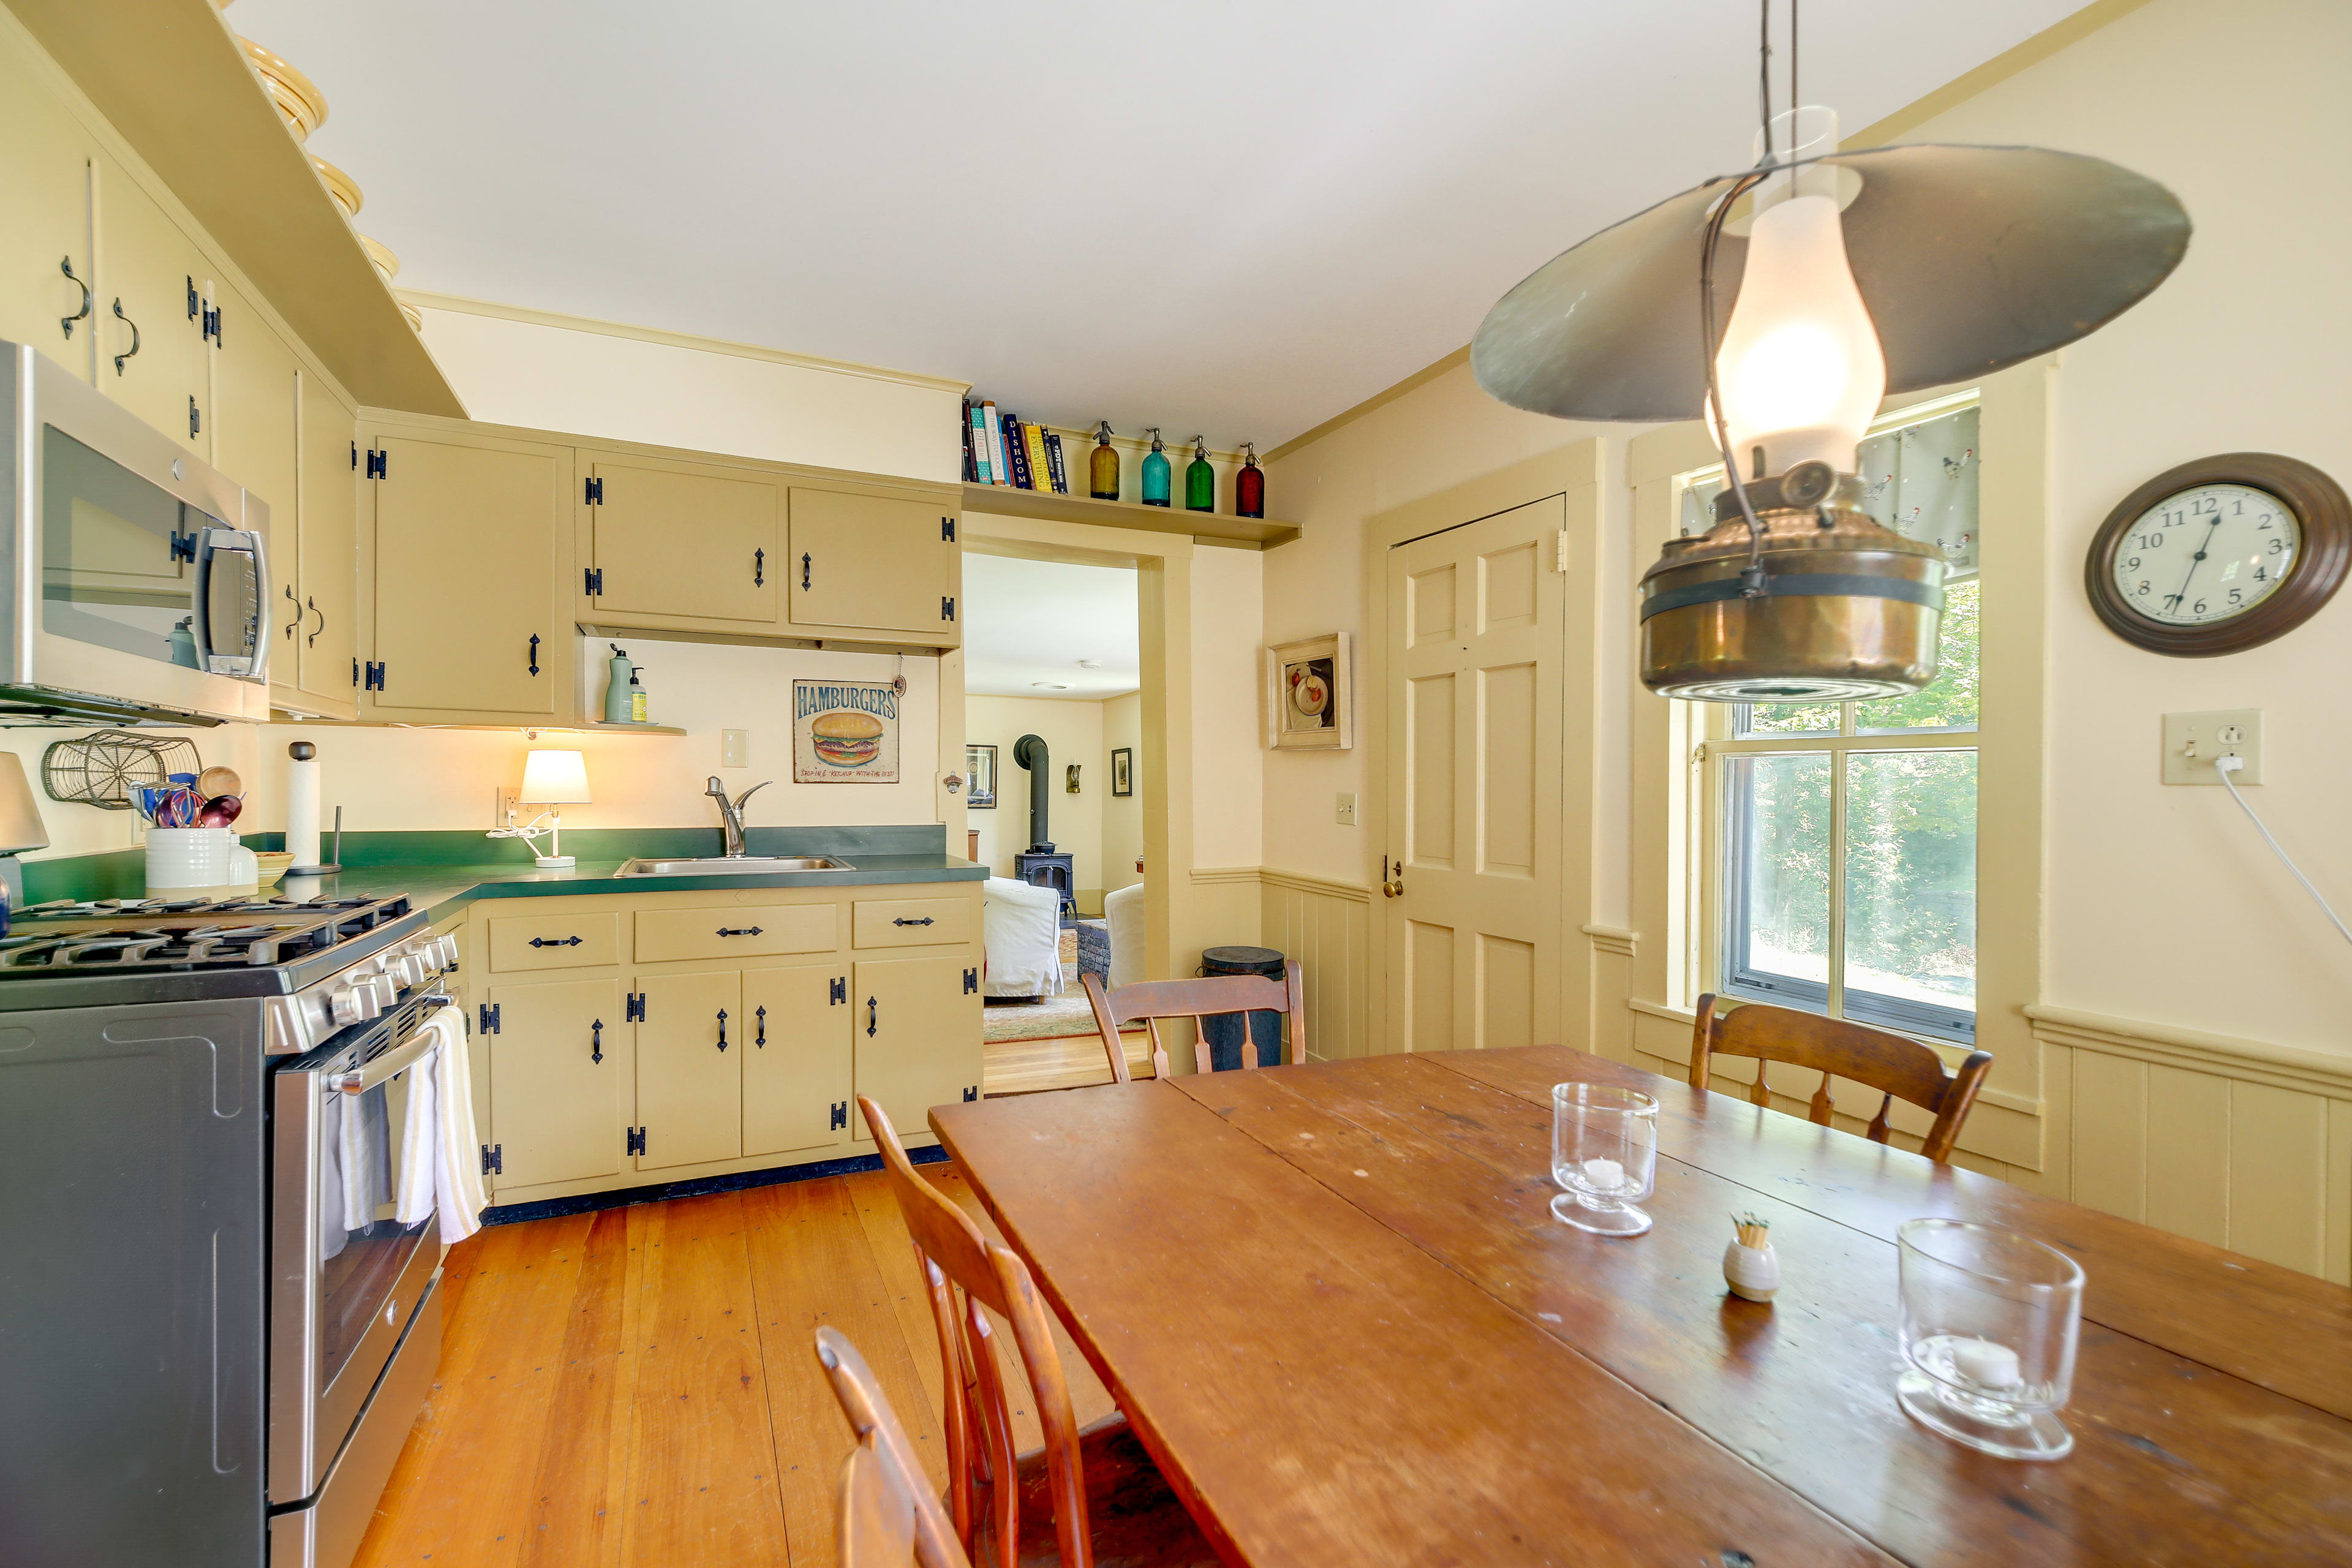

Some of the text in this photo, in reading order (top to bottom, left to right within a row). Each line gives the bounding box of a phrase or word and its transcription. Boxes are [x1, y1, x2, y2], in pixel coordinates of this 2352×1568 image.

[993, 443, 999, 452] TO
[1009, 421, 1027, 483] DISHOOM
[1031, 436, 1045, 487] EVERYTHING
[1041, 456, 1047, 464] TO
[2191, 497, 2218, 516] 12
[2232, 500, 2244, 516] 1
[2162, 510, 2186, 527] 11
[2257, 513, 2272, 530] 2
[2138, 533, 2163, 549] 10
[2268, 538, 2283, 555] 3
[2128, 557, 2141, 572] 9
[2252, 566, 2267, 581] 4
[2138, 580, 2150, 595] 8
[2163, 594, 2177, 609] 7
[2227, 588, 2242, 605] 5
[2193, 598, 2206, 614] 6
[797, 686, 895, 720] HAMBURGERS
